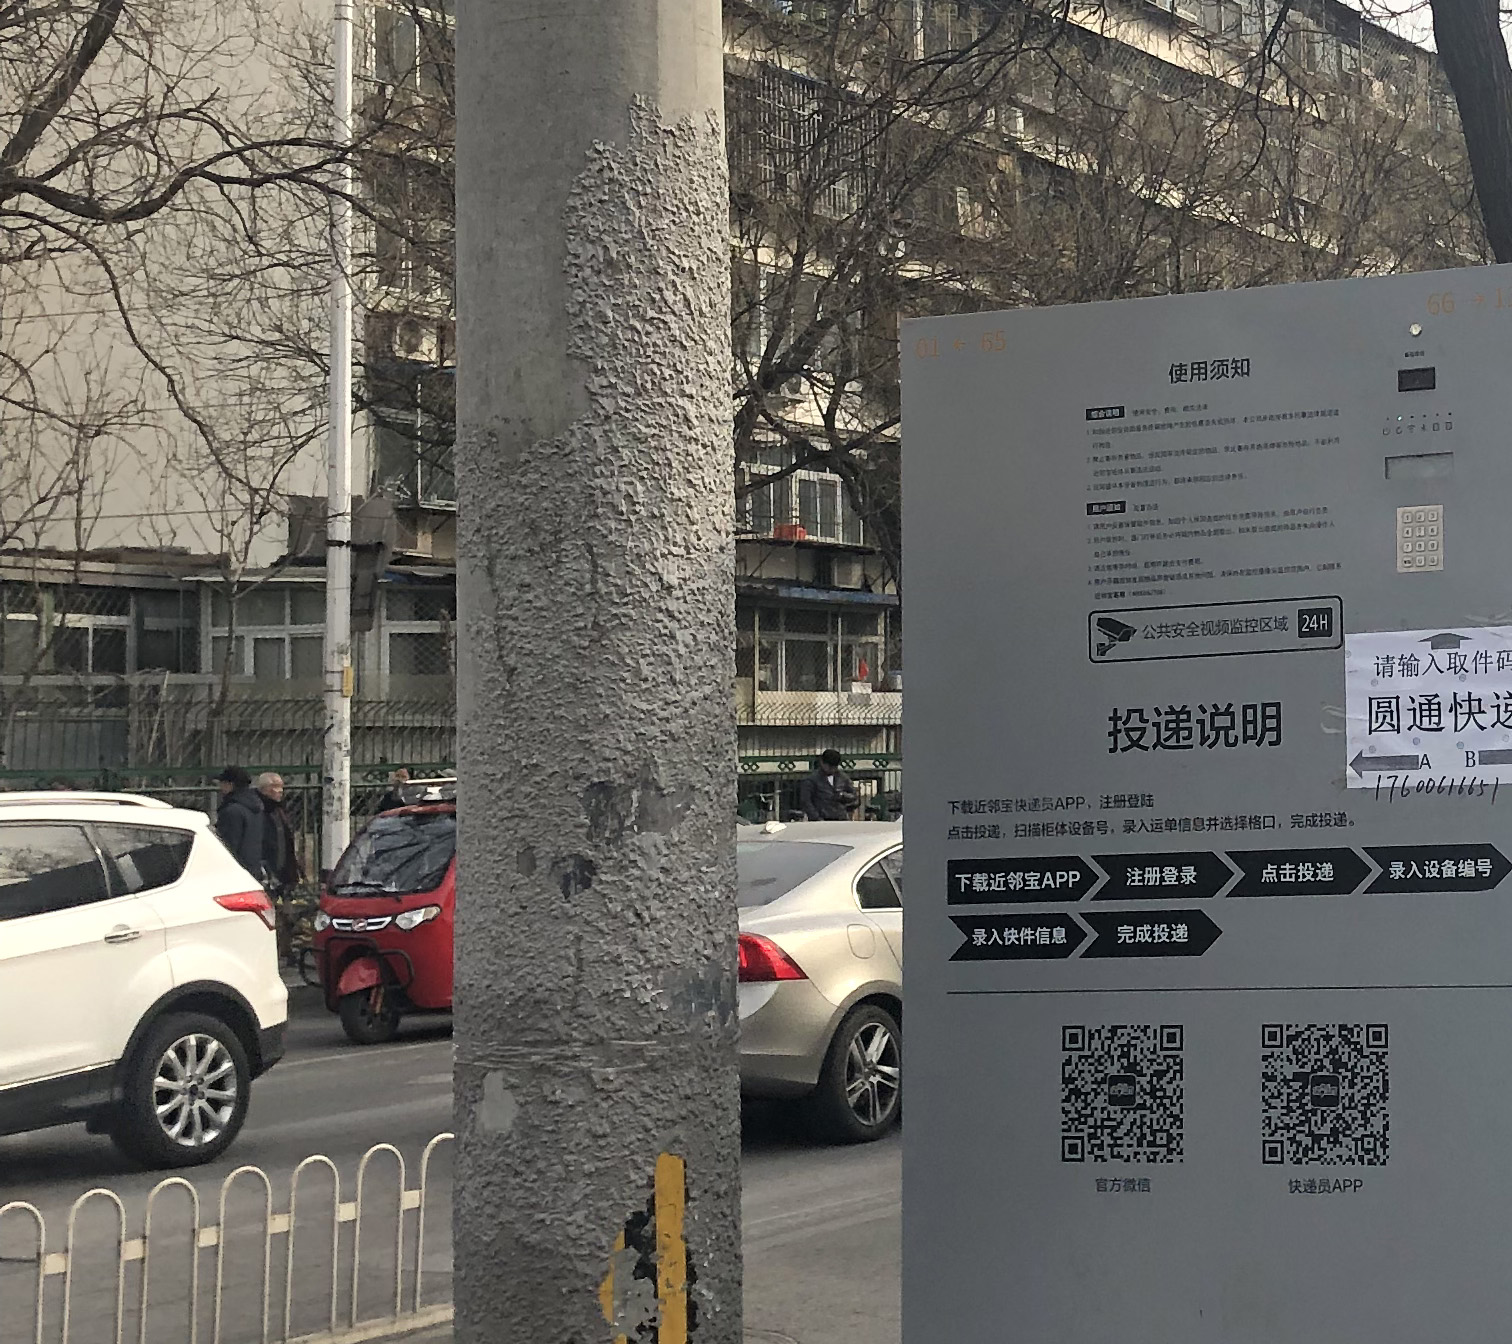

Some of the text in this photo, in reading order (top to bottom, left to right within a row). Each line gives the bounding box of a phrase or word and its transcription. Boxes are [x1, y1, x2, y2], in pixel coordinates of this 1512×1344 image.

[1427, 290, 1455, 315] 66
[915, 335, 940, 358] 01
[1168, 357, 1250, 384] 使用须知
[1142, 614, 1329, 640] 公共安全视频监控区域 24H
[1108, 702, 1282, 754] 投递说明
[1419, 750, 1476, 770] A B
[1126, 866, 1197, 886] 注册登录
[1261, 861, 1334, 884] 点击投递
[1388, 858, 1493, 880] 录入设备编号
[955, 870, 1081, 893] 下载近邻宝APP
[971, 926, 1067, 947] 录入快件信息
[1117, 923, 1189, 944] 完成投递
[1095, 1177, 1151, 1193] 官方微信
[1288, 1178, 1364, 1195] 快递员APP
